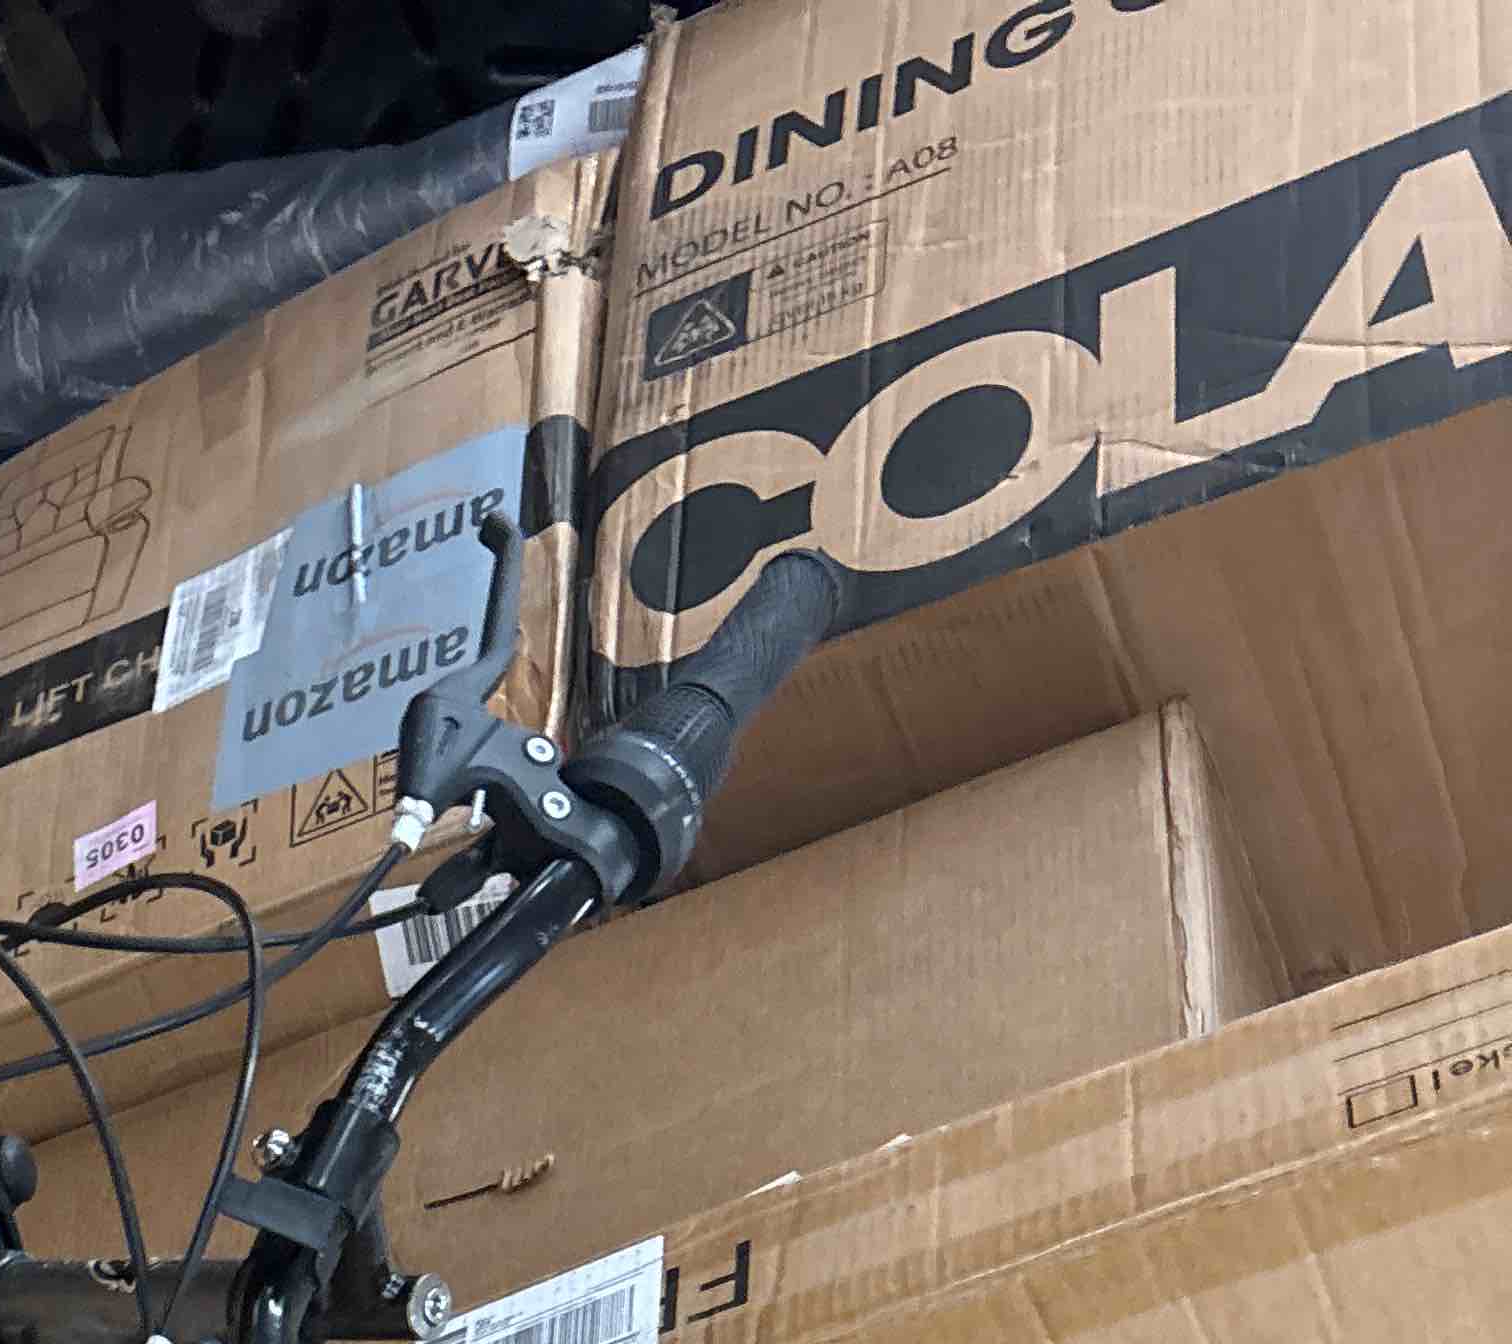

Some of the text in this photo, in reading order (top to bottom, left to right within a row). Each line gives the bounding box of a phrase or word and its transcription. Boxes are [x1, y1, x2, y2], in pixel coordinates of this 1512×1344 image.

[649, 0, 1076, 221] DINING
[636, 208, 771, 286] MODEL
[885, 135, 959, 181] A08
[12, 672, 94, 728] LIFT
[103, 645, 162, 689] CH
[243, 625, 469, 741] amazon
[86, 823, 145, 870] 0305
